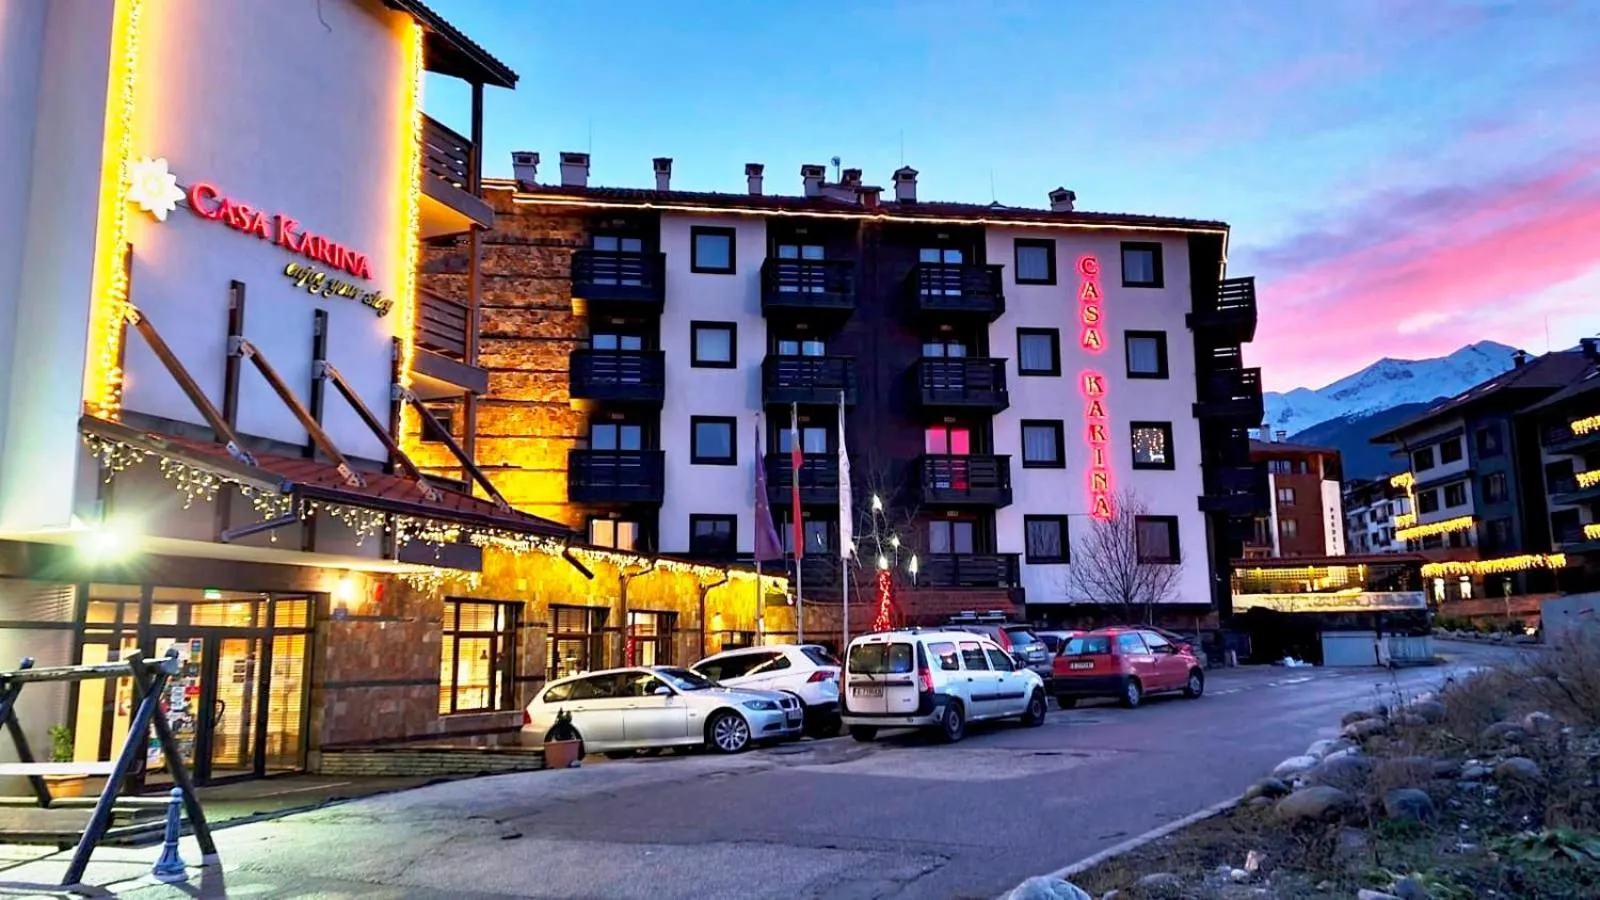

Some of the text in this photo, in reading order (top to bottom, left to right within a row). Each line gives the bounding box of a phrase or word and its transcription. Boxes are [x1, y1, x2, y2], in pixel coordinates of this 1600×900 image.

[187, 182, 373, 280] CASA KARINA
[1079, 256, 1111, 516] CASA KARINA
